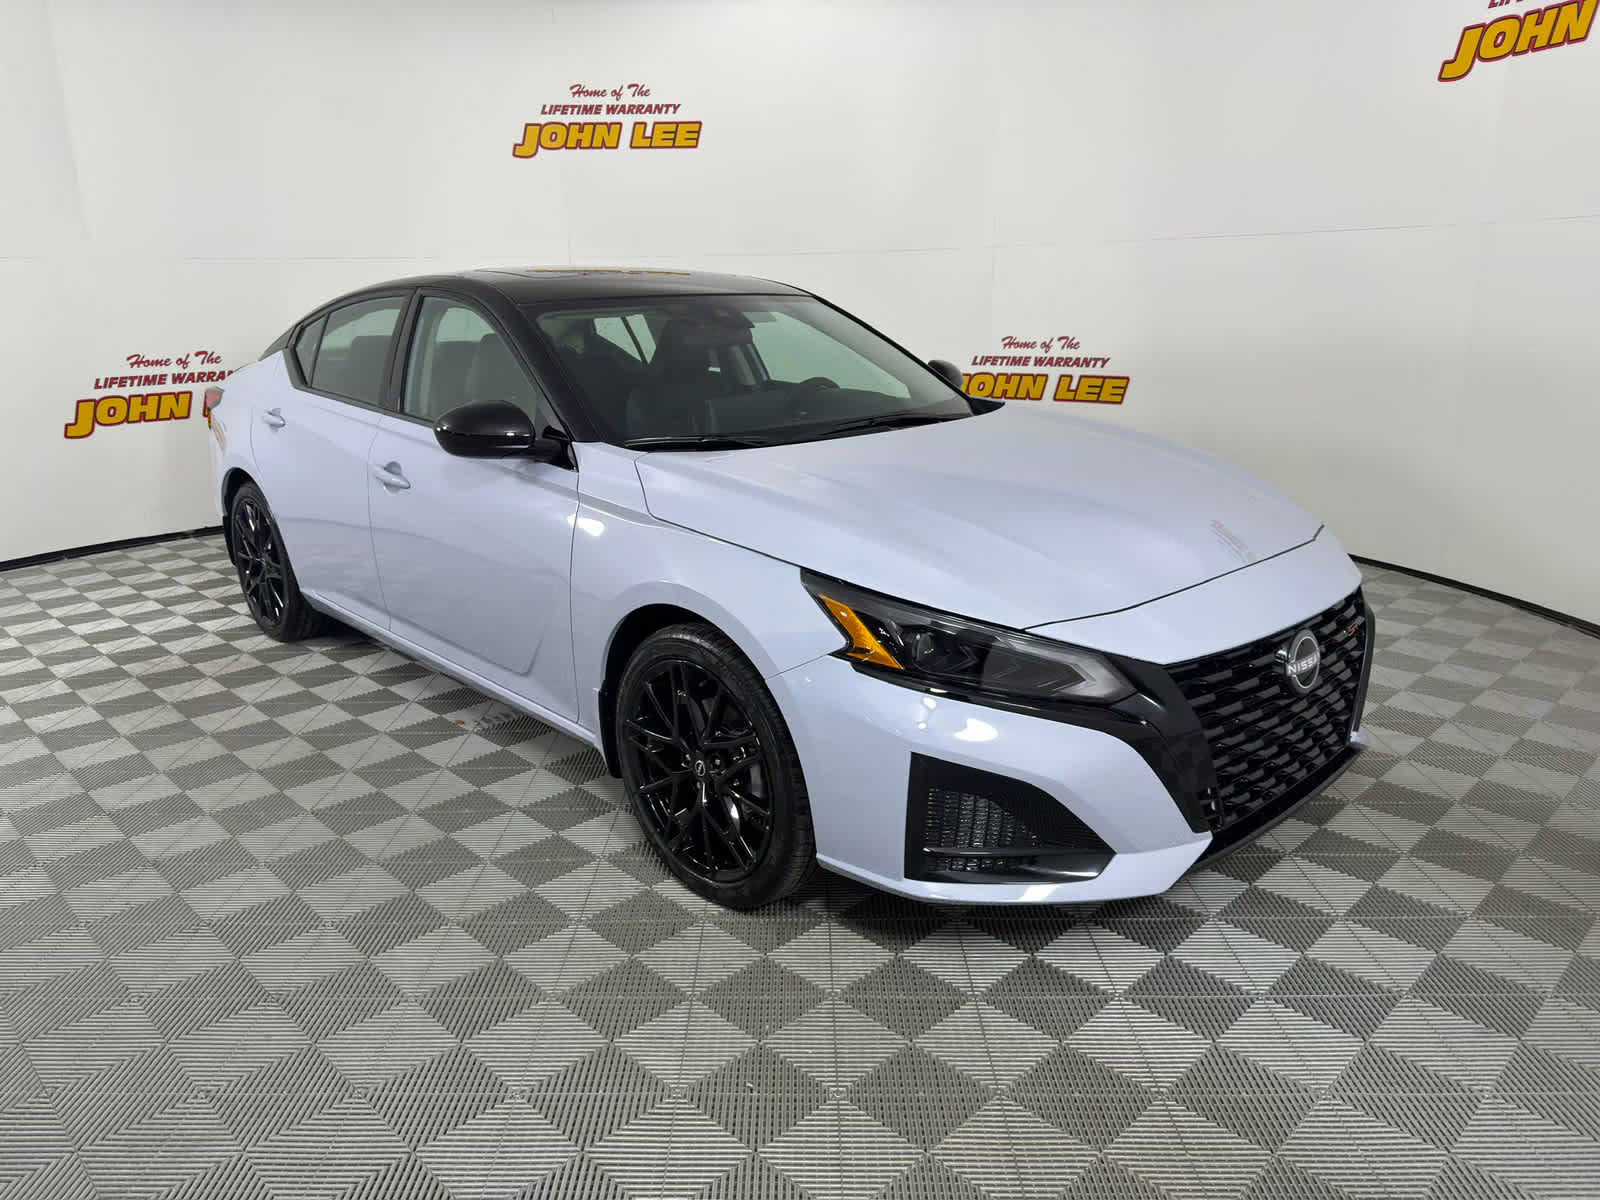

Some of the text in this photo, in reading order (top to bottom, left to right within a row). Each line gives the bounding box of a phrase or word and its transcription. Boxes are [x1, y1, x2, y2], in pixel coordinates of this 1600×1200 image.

[1438, 0, 1599, 82] JOHN
[569, 83, 651, 101] Home of The
[540, 103, 681, 115] LIFETIME WARRANTY
[512, 121, 702, 158] JOHN LEE
[1001, 336, 1080, 353] Home of The
[126, 351, 223, 370] Home of The
[971, 355, 1110, 368] LIFETIME WARRANTY
[94, 370, 234, 390] LIFETIME WARRA
[1053, 374, 1130, 405] LEE
[64, 391, 193, 440] JOHN
